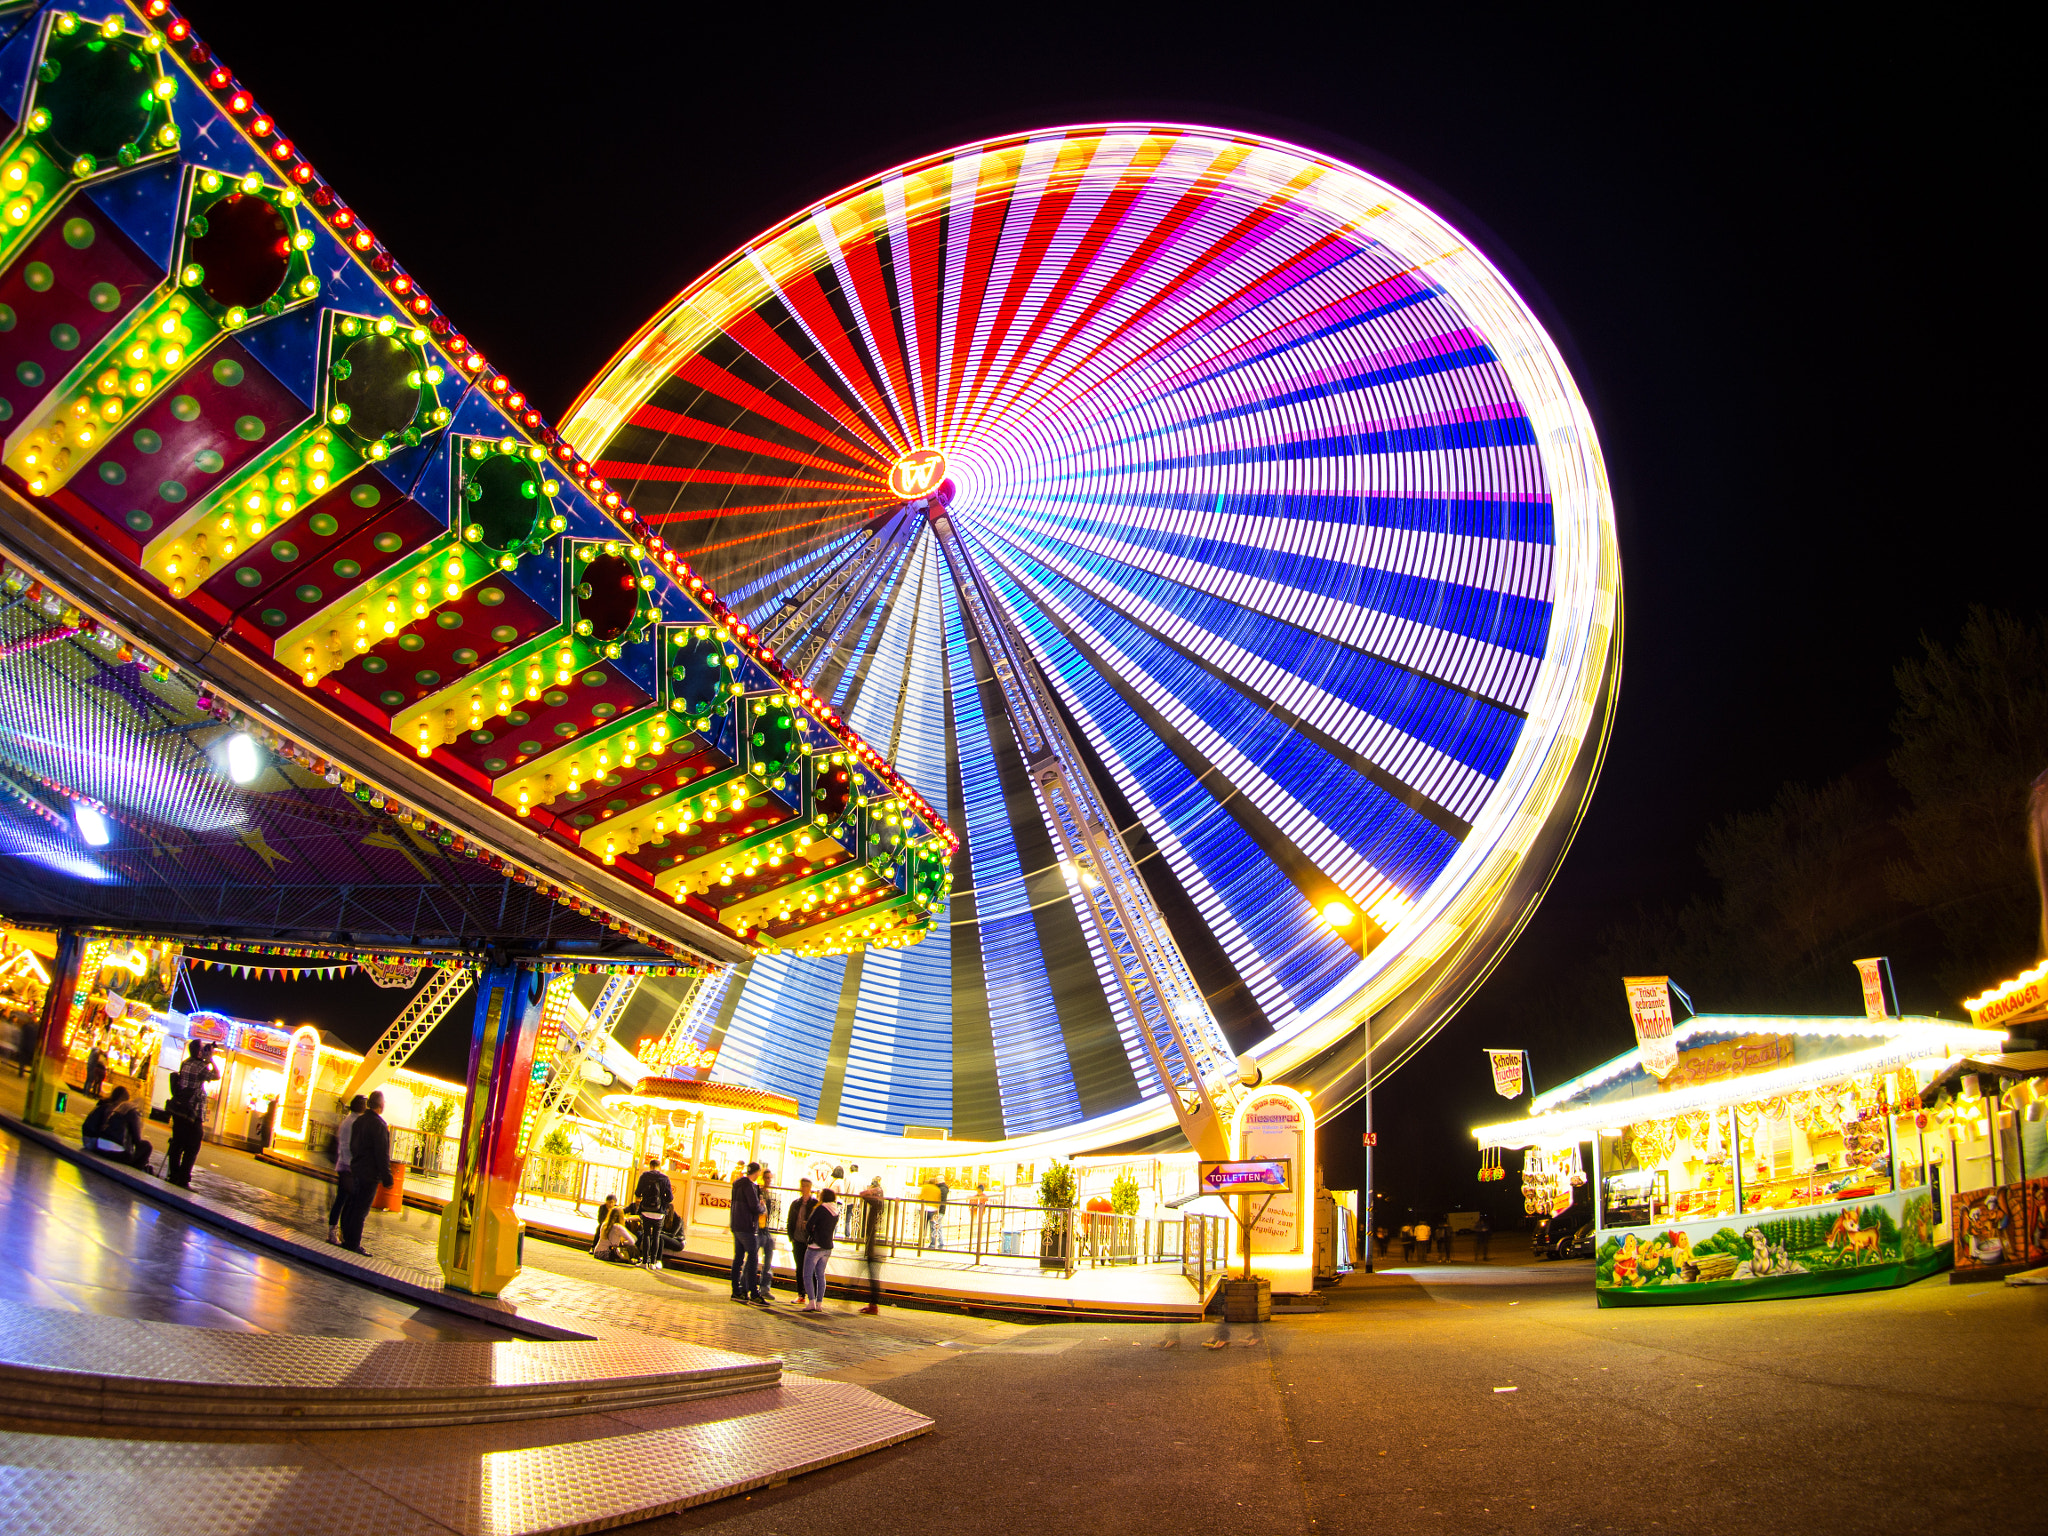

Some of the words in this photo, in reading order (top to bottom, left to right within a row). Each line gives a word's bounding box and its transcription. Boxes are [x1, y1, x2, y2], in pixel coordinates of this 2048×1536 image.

[898, 454, 942, 493] W
[1635, 997, 1666, 1012] gebrannte
[1979, 984, 2041, 1024] KRAKAUER
[1635, 1009, 1673, 1039] Mandeln
[1245, 1112, 1301, 1123] Riesenrad
[1364, 1133, 1377, 1145] 43
[1209, 1173, 1261, 1183] TOILETTEN
[1252, 1224, 1289, 1238] ergnügen!
[1276, 1219, 1294, 1229] zum
